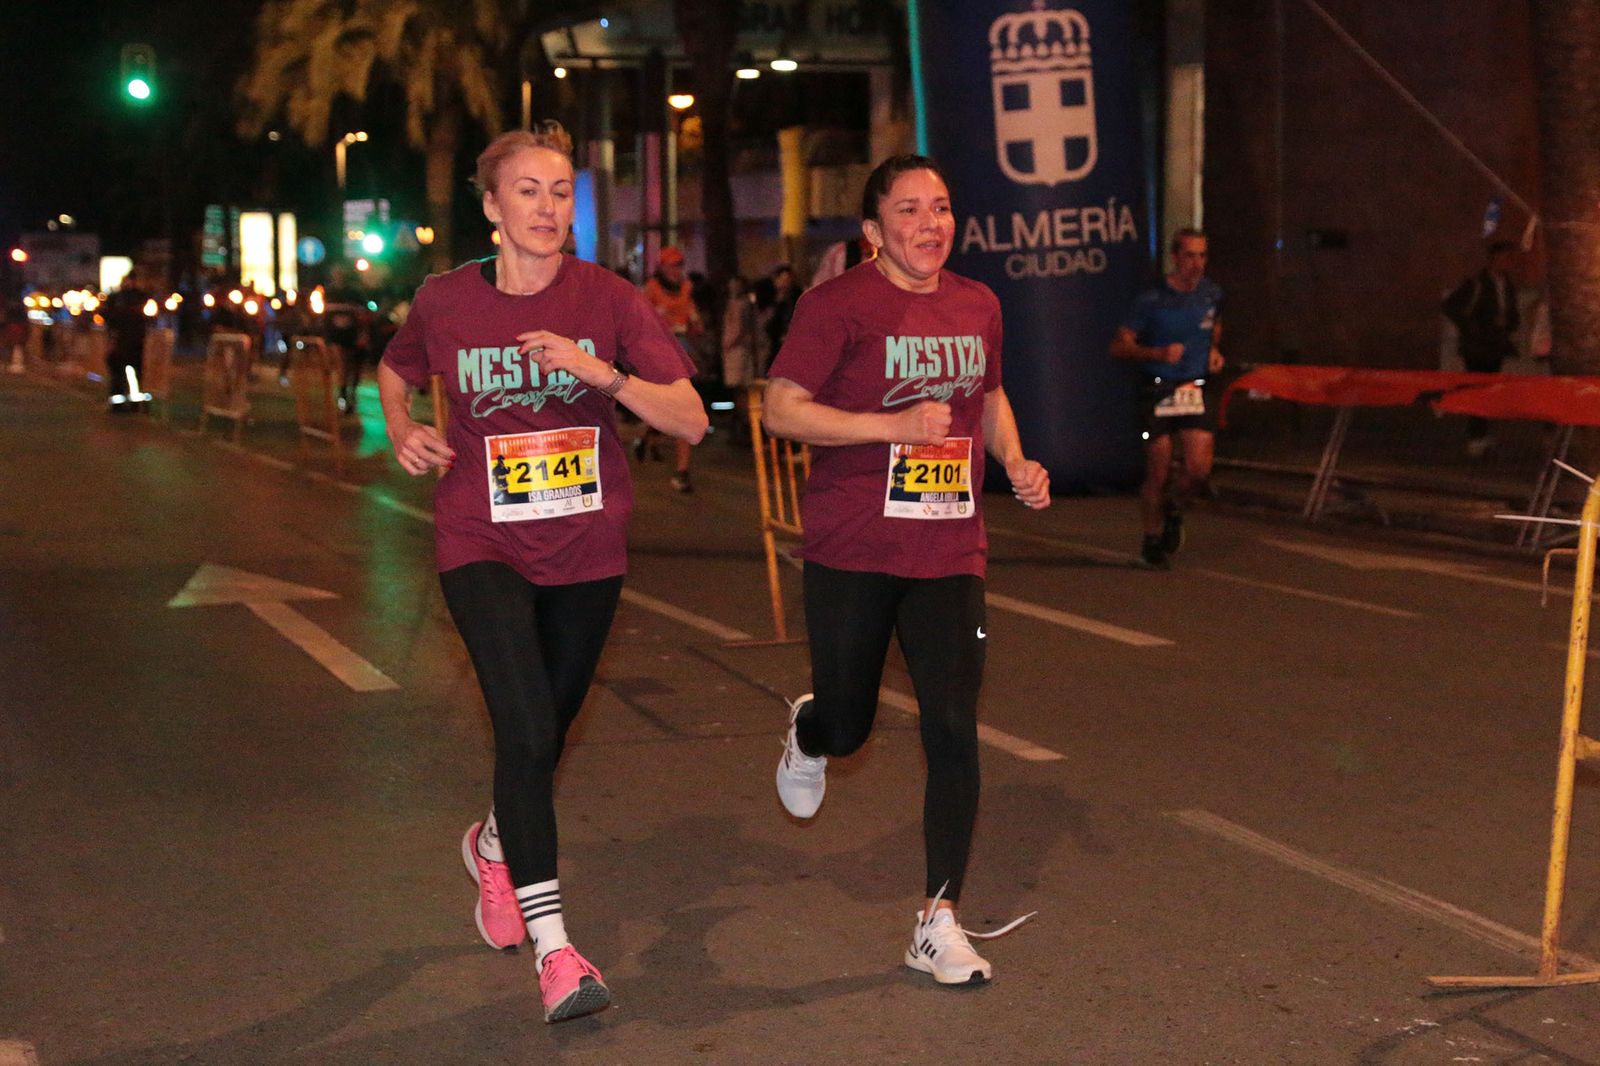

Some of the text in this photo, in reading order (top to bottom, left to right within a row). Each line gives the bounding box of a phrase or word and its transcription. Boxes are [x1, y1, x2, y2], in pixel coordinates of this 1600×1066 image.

[960, 196, 1138, 253] ALMERÍA
[1005, 247, 1108, 280] CIUDAD
[515, 454, 581, 484] 2141
[914, 463, 961, 484] 2101
[528, 485, 582, 502] ISA GRANADOS
